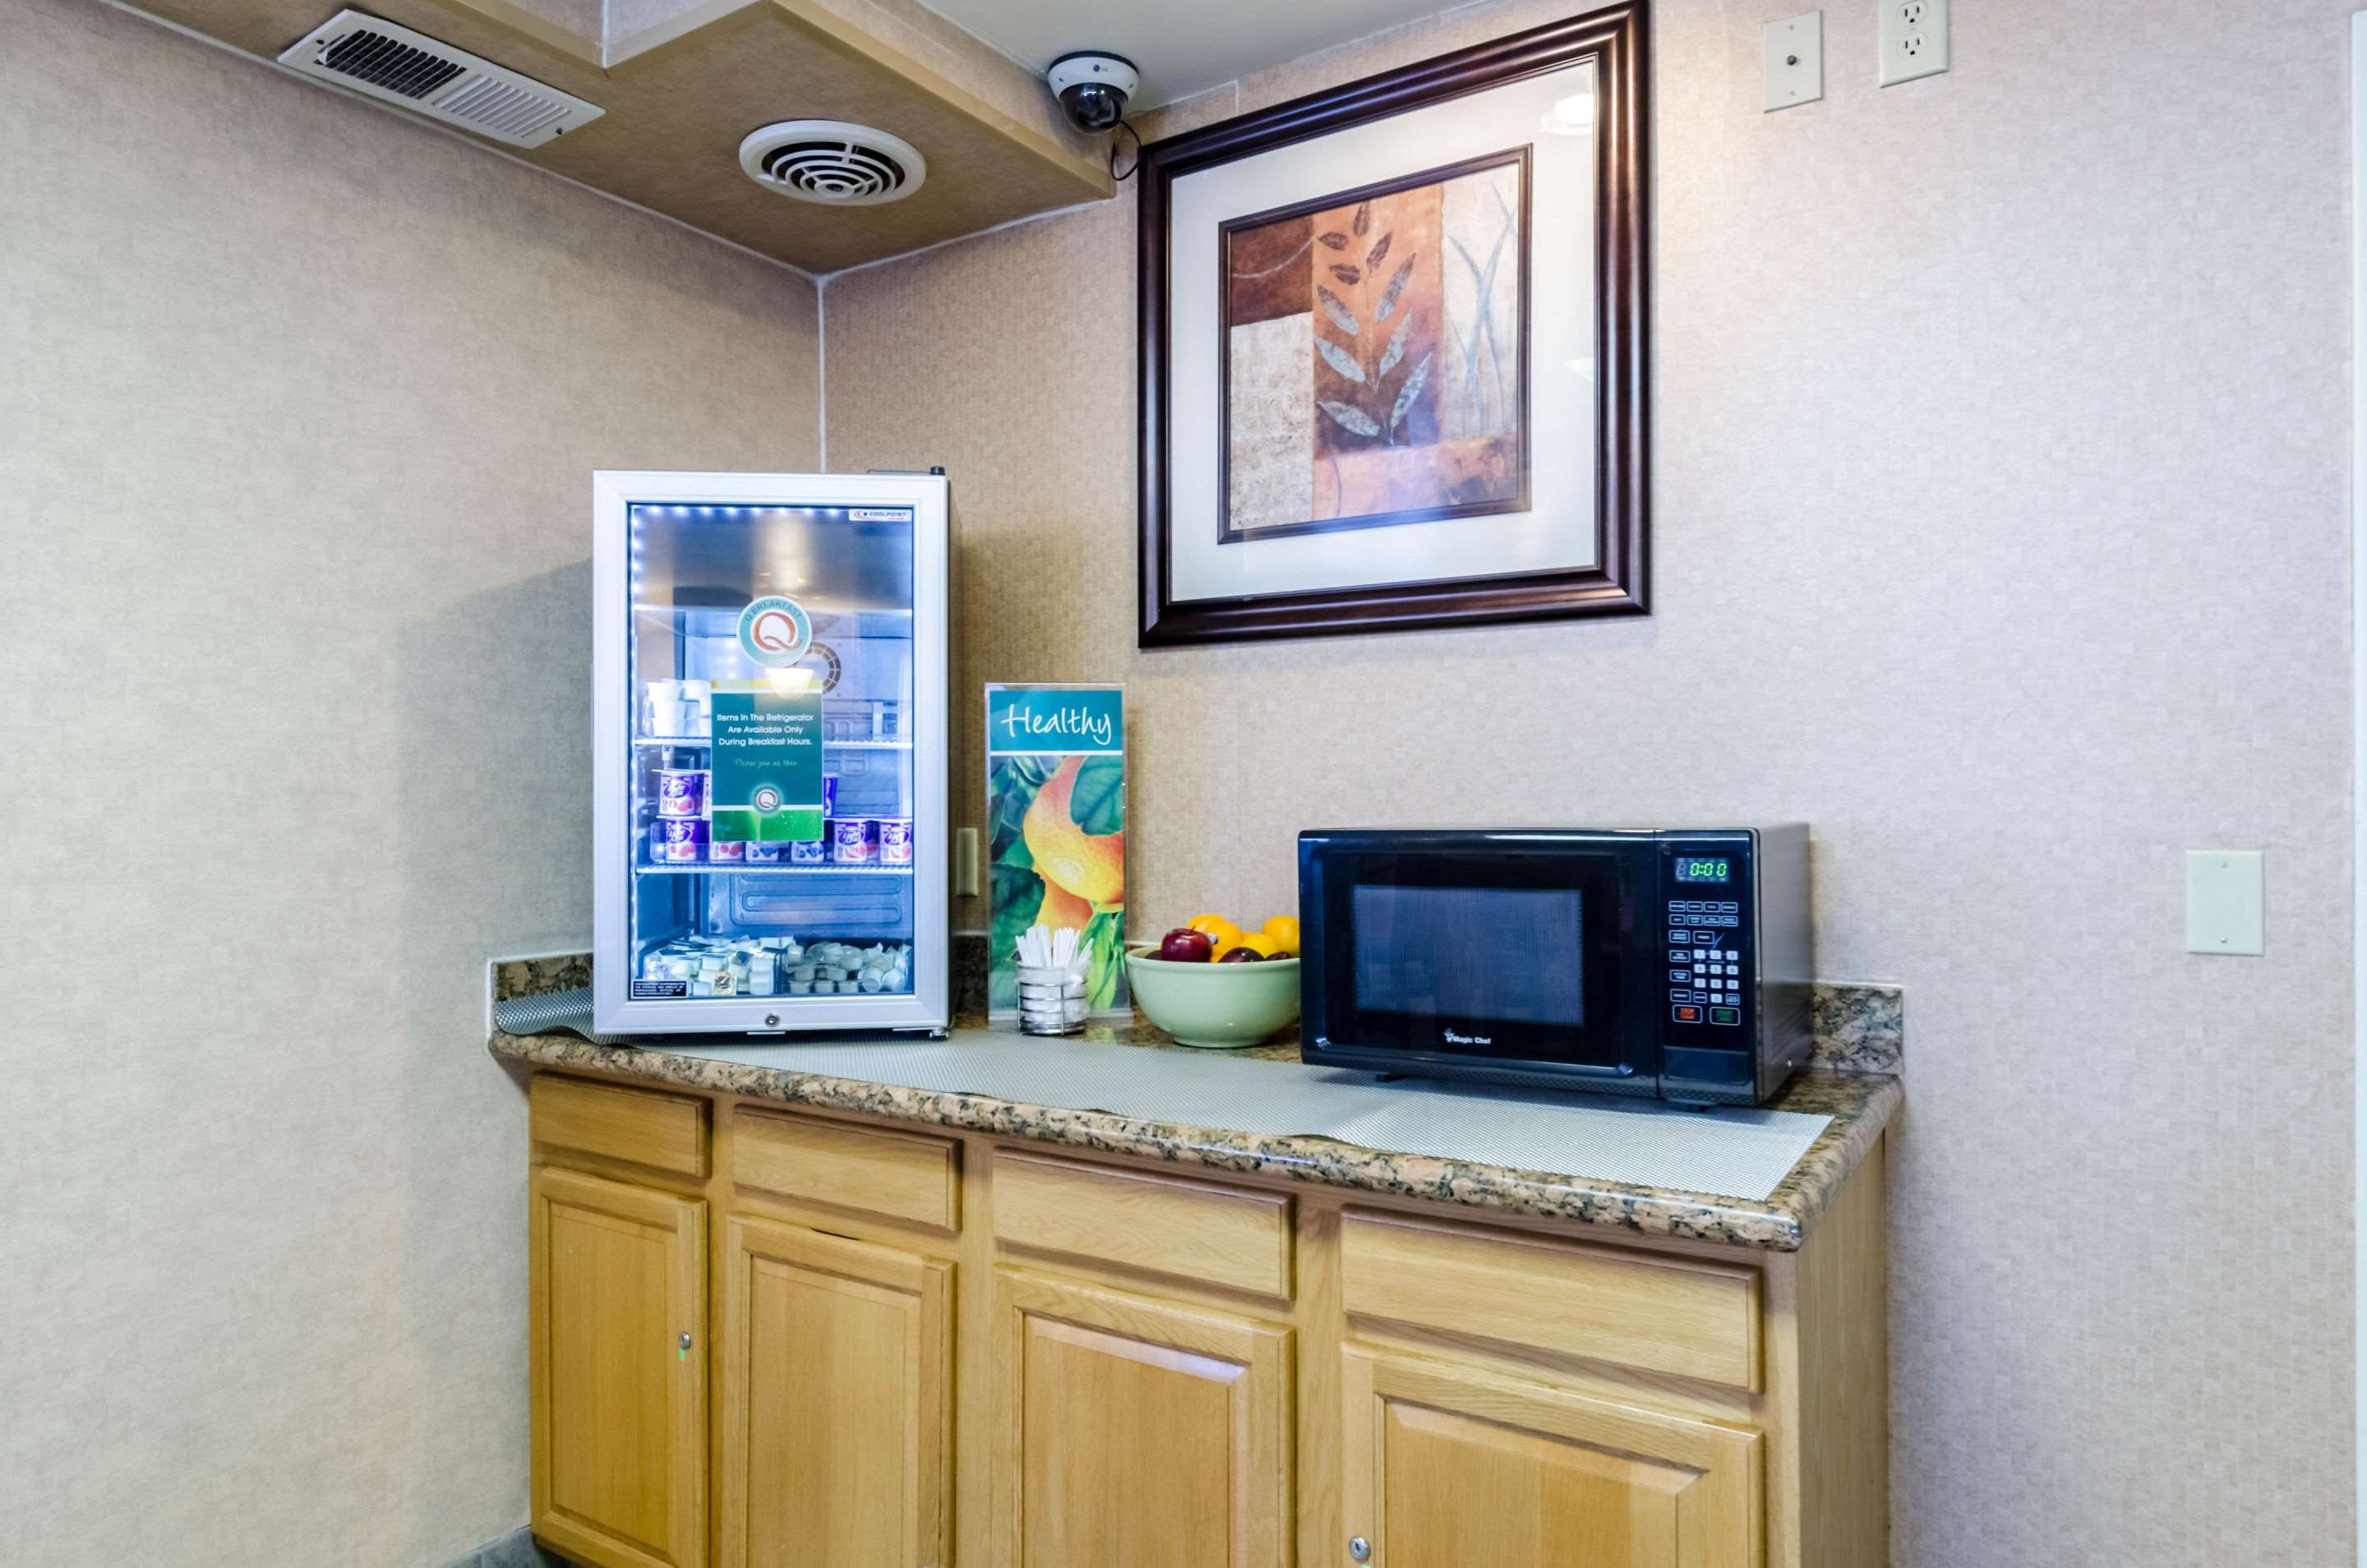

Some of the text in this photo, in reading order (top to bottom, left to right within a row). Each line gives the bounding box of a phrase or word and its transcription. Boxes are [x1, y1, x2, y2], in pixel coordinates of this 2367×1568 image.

[753, 600, 803, 619] BREAKFAST
[752, 611, 802, 651] Q
[717, 713, 814, 722] Items In The Refrigerator
[1000, 703, 1111, 745] Healthy
[783, 726, 804, 735] Only
[718, 738, 746, 747] During
[735, 758, 756, 767] Please
[757, 759, 770, 769] join
[758, 791, 777, 809] Q
[1690, 862, 1727, 877] 0:00
[1452, 1035, 1492, 1045] Magic Chef
